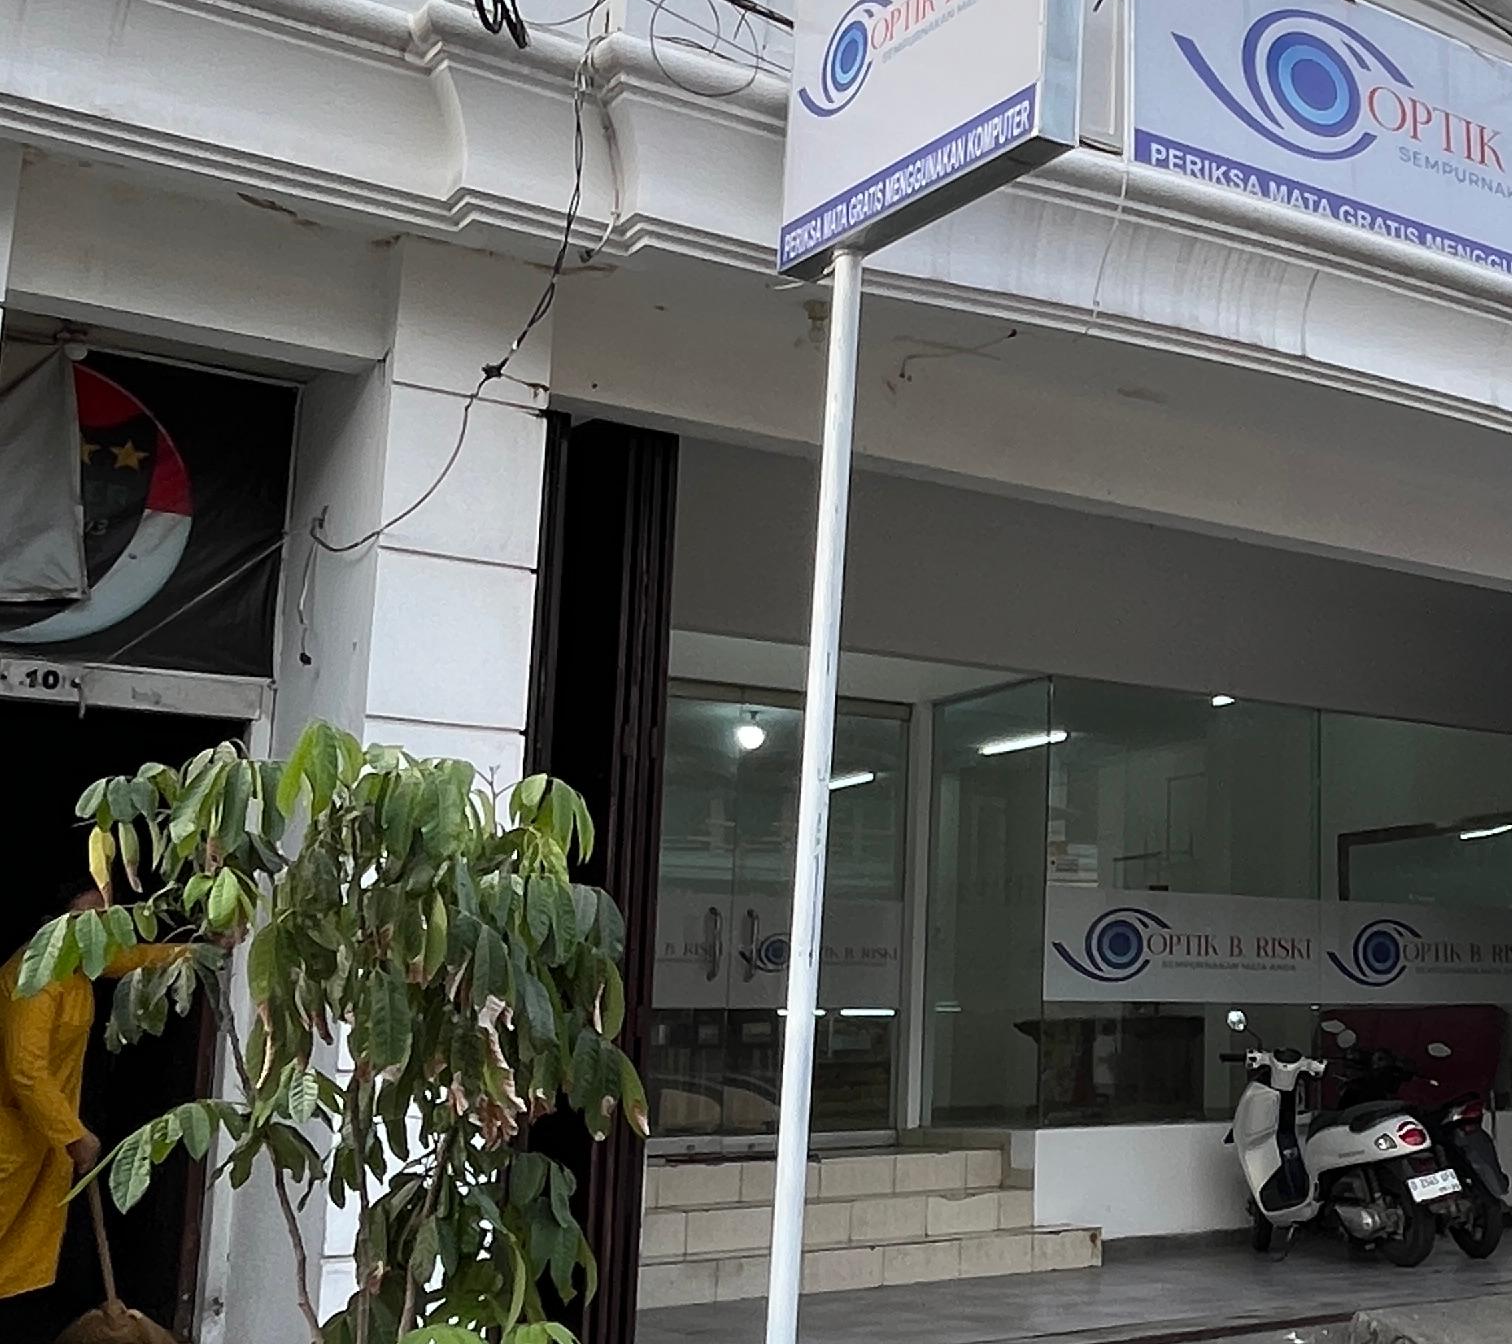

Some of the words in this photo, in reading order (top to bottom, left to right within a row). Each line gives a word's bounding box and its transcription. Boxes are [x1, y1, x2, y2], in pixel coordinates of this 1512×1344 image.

[1367, 86, 1505, 174] OPTIK
[783, 215, 821, 261] PERIKSA
[822, 204, 848, 241] MATA
[849, 181, 883, 226] GRATIS
[885, 139, 965, 206] MENGGUNAKAN
[966, 100, 1031, 160] KOMPUTER
[1150, 143, 1263, 198] PERIKSA
[1268, 181, 1333, 218] MATA
[1338, 205, 1419, 246] GRATIS
[1146, 933, 1220, 957] OPTIK
[1255, 936, 1313, 961] RISKI
[1402, 941, 1461, 963] OPTIK
